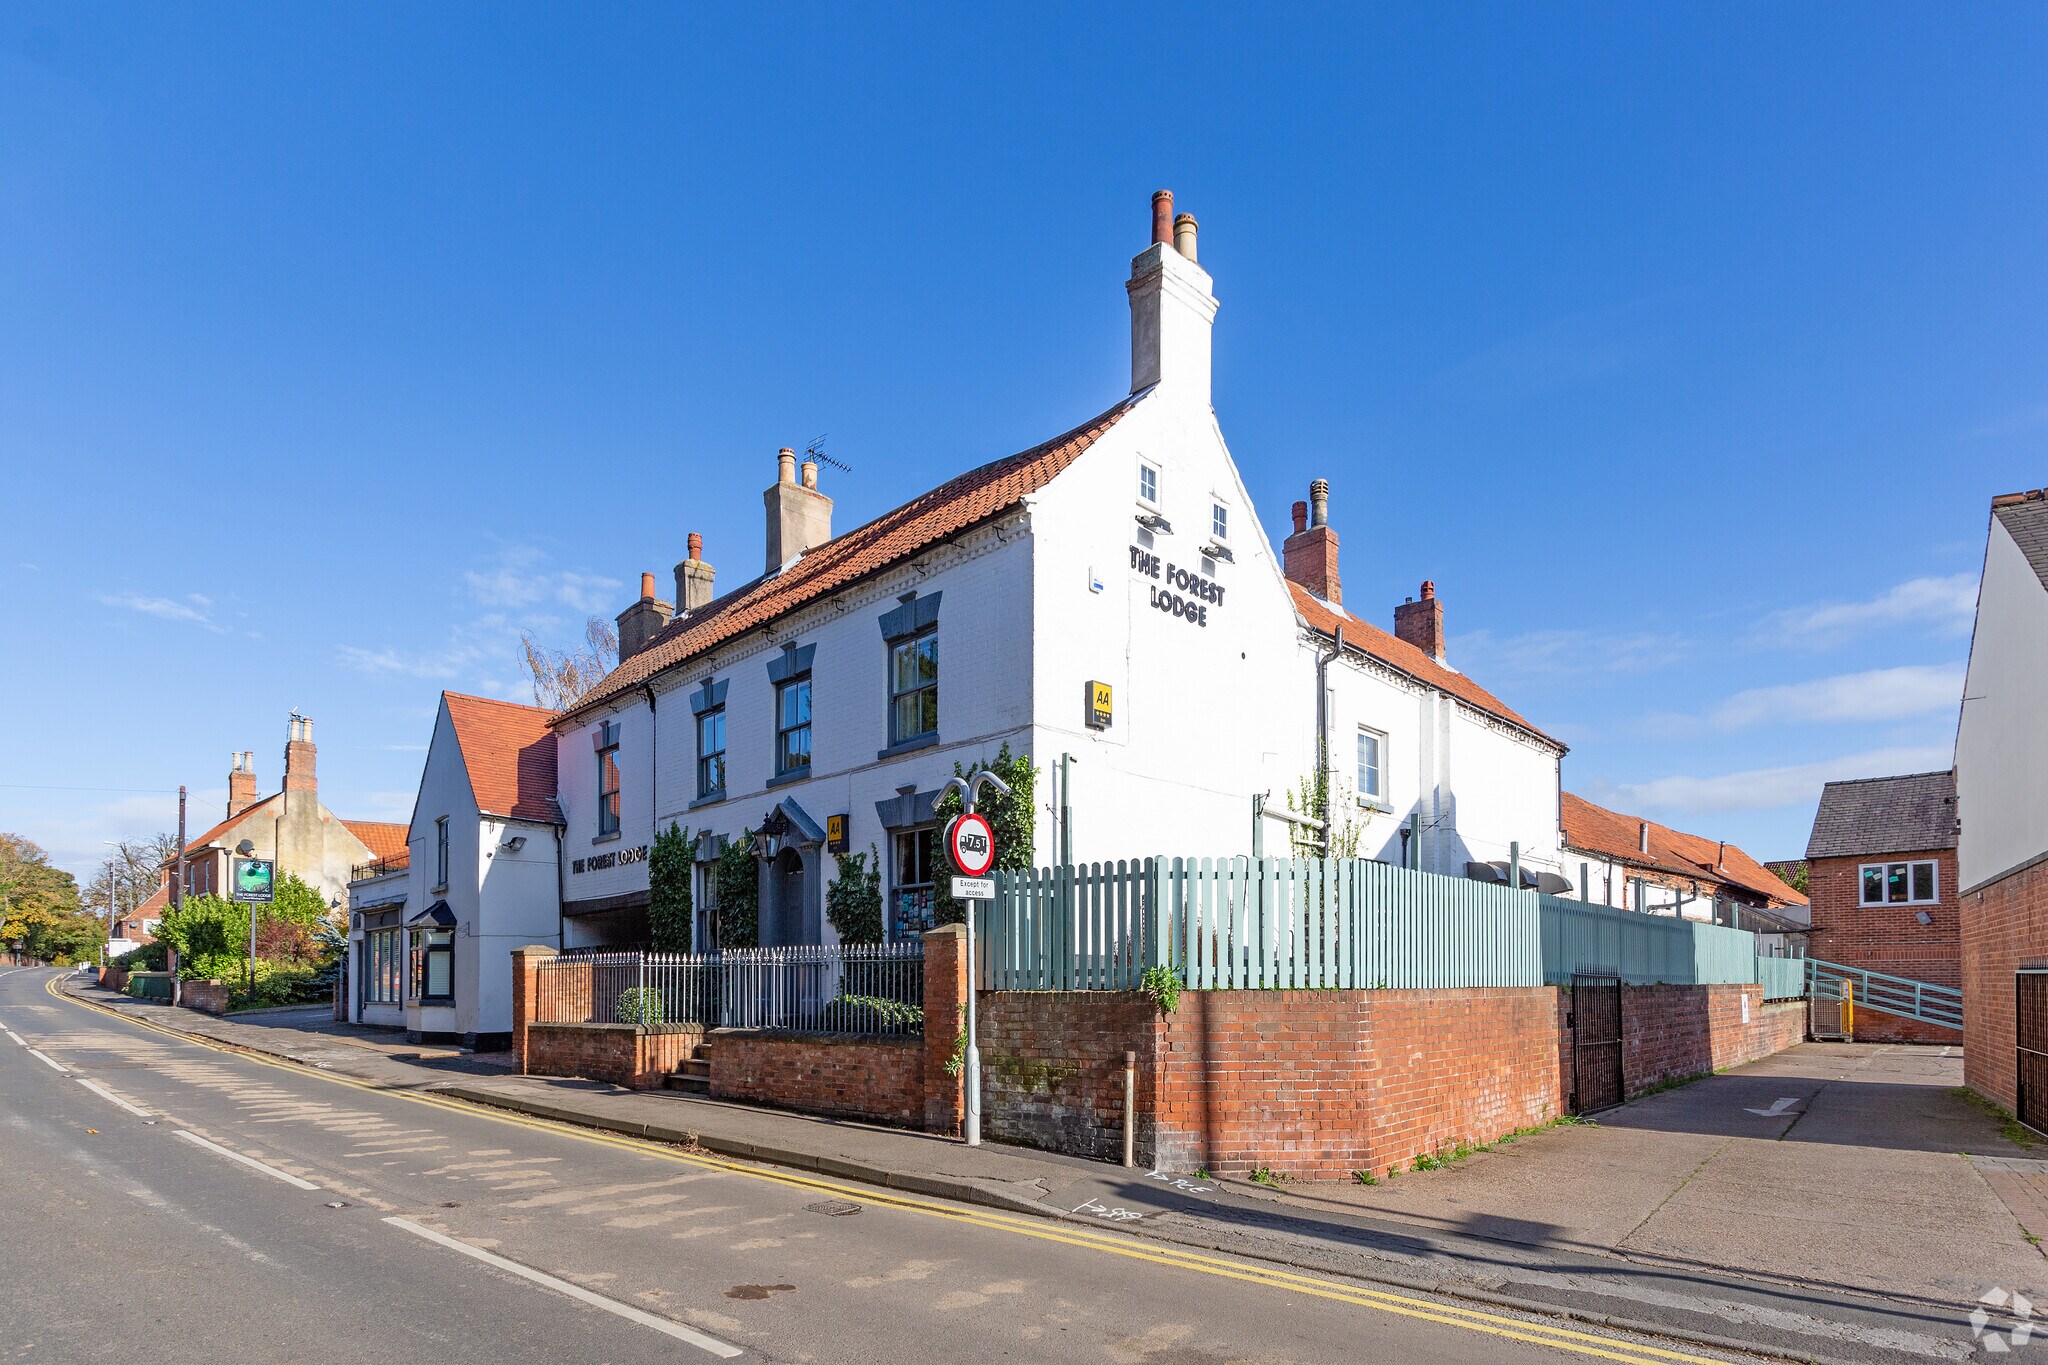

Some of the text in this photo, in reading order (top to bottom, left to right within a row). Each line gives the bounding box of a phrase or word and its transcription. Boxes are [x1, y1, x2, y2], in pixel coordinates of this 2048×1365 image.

[1129, 545, 1226, 607] THE FOREST
[1151, 585, 1207, 628] LODGE
[1097, 691, 1109, 706] AA
[830, 822, 840, 835] AA
[572, 845, 648, 874] THE FOREST LODGE
[960, 879, 989, 888] Except for
